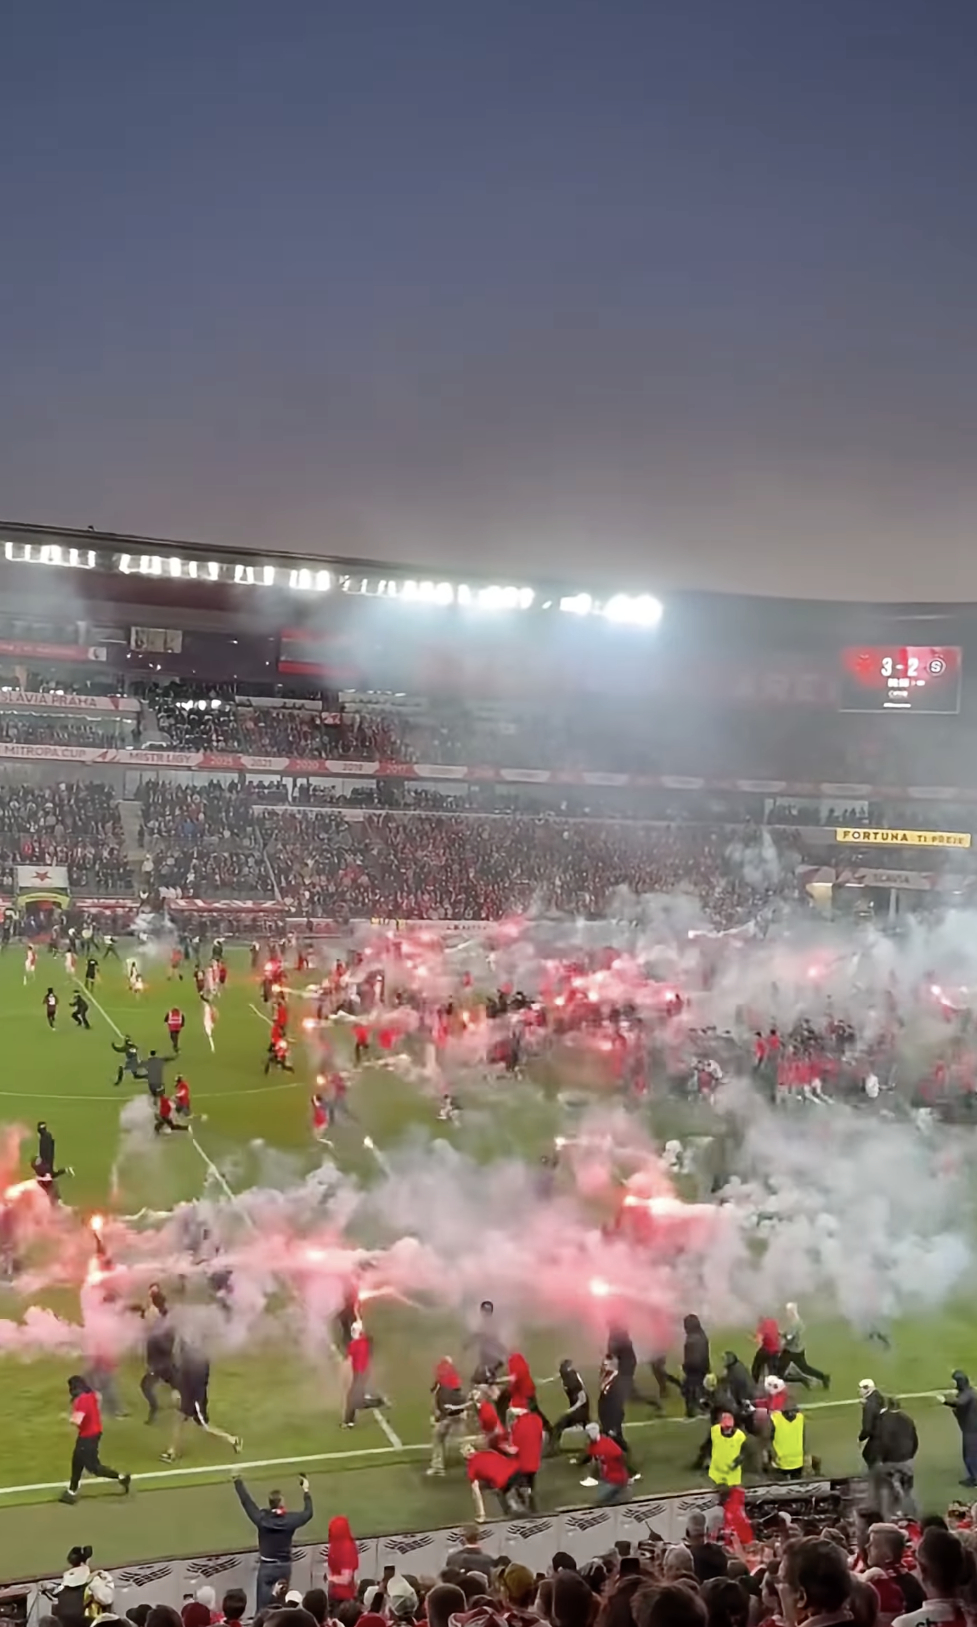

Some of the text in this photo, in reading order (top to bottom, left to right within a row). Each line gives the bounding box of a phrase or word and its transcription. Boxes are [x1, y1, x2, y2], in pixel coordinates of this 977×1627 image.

[1, 690, 97, 707] SLAVIA PRAHA
[4, 745, 87, 758] MITROPA CUP
[842, 830, 909, 842] FORTUNA
[917, 834, 928, 843] TI
